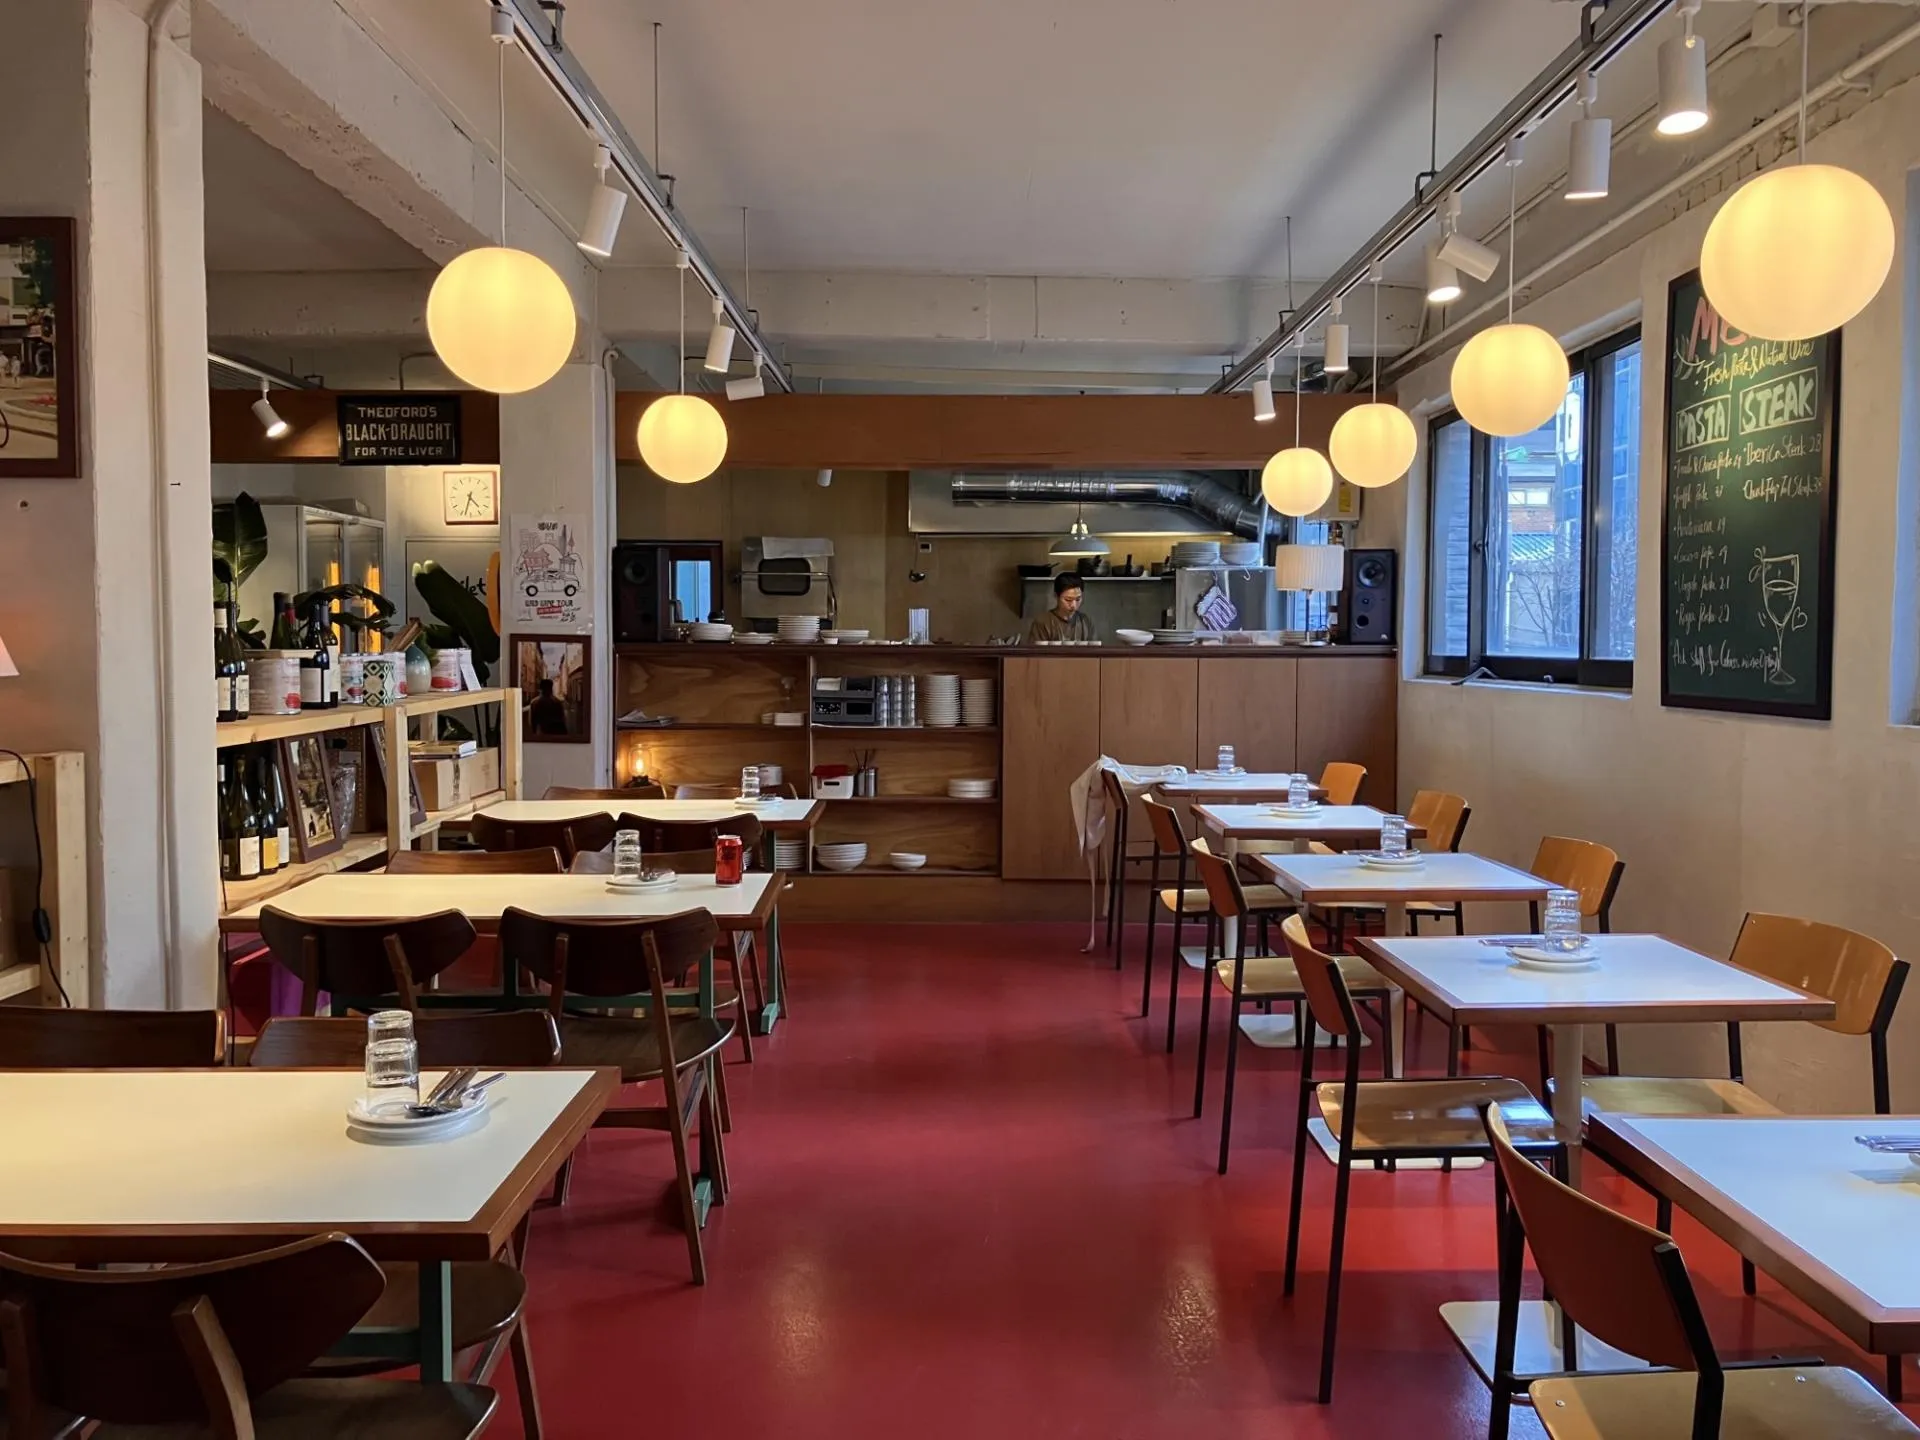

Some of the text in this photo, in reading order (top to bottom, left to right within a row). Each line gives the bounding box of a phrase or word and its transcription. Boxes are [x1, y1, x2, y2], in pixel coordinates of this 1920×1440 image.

[1742, 375, 1814, 433] STEAK
[346, 423, 452, 441] BLACK-DRAUGHT
[1678, 401, 1726, 447] PASTA
[355, 446, 443, 456] FOR THE LIVER
